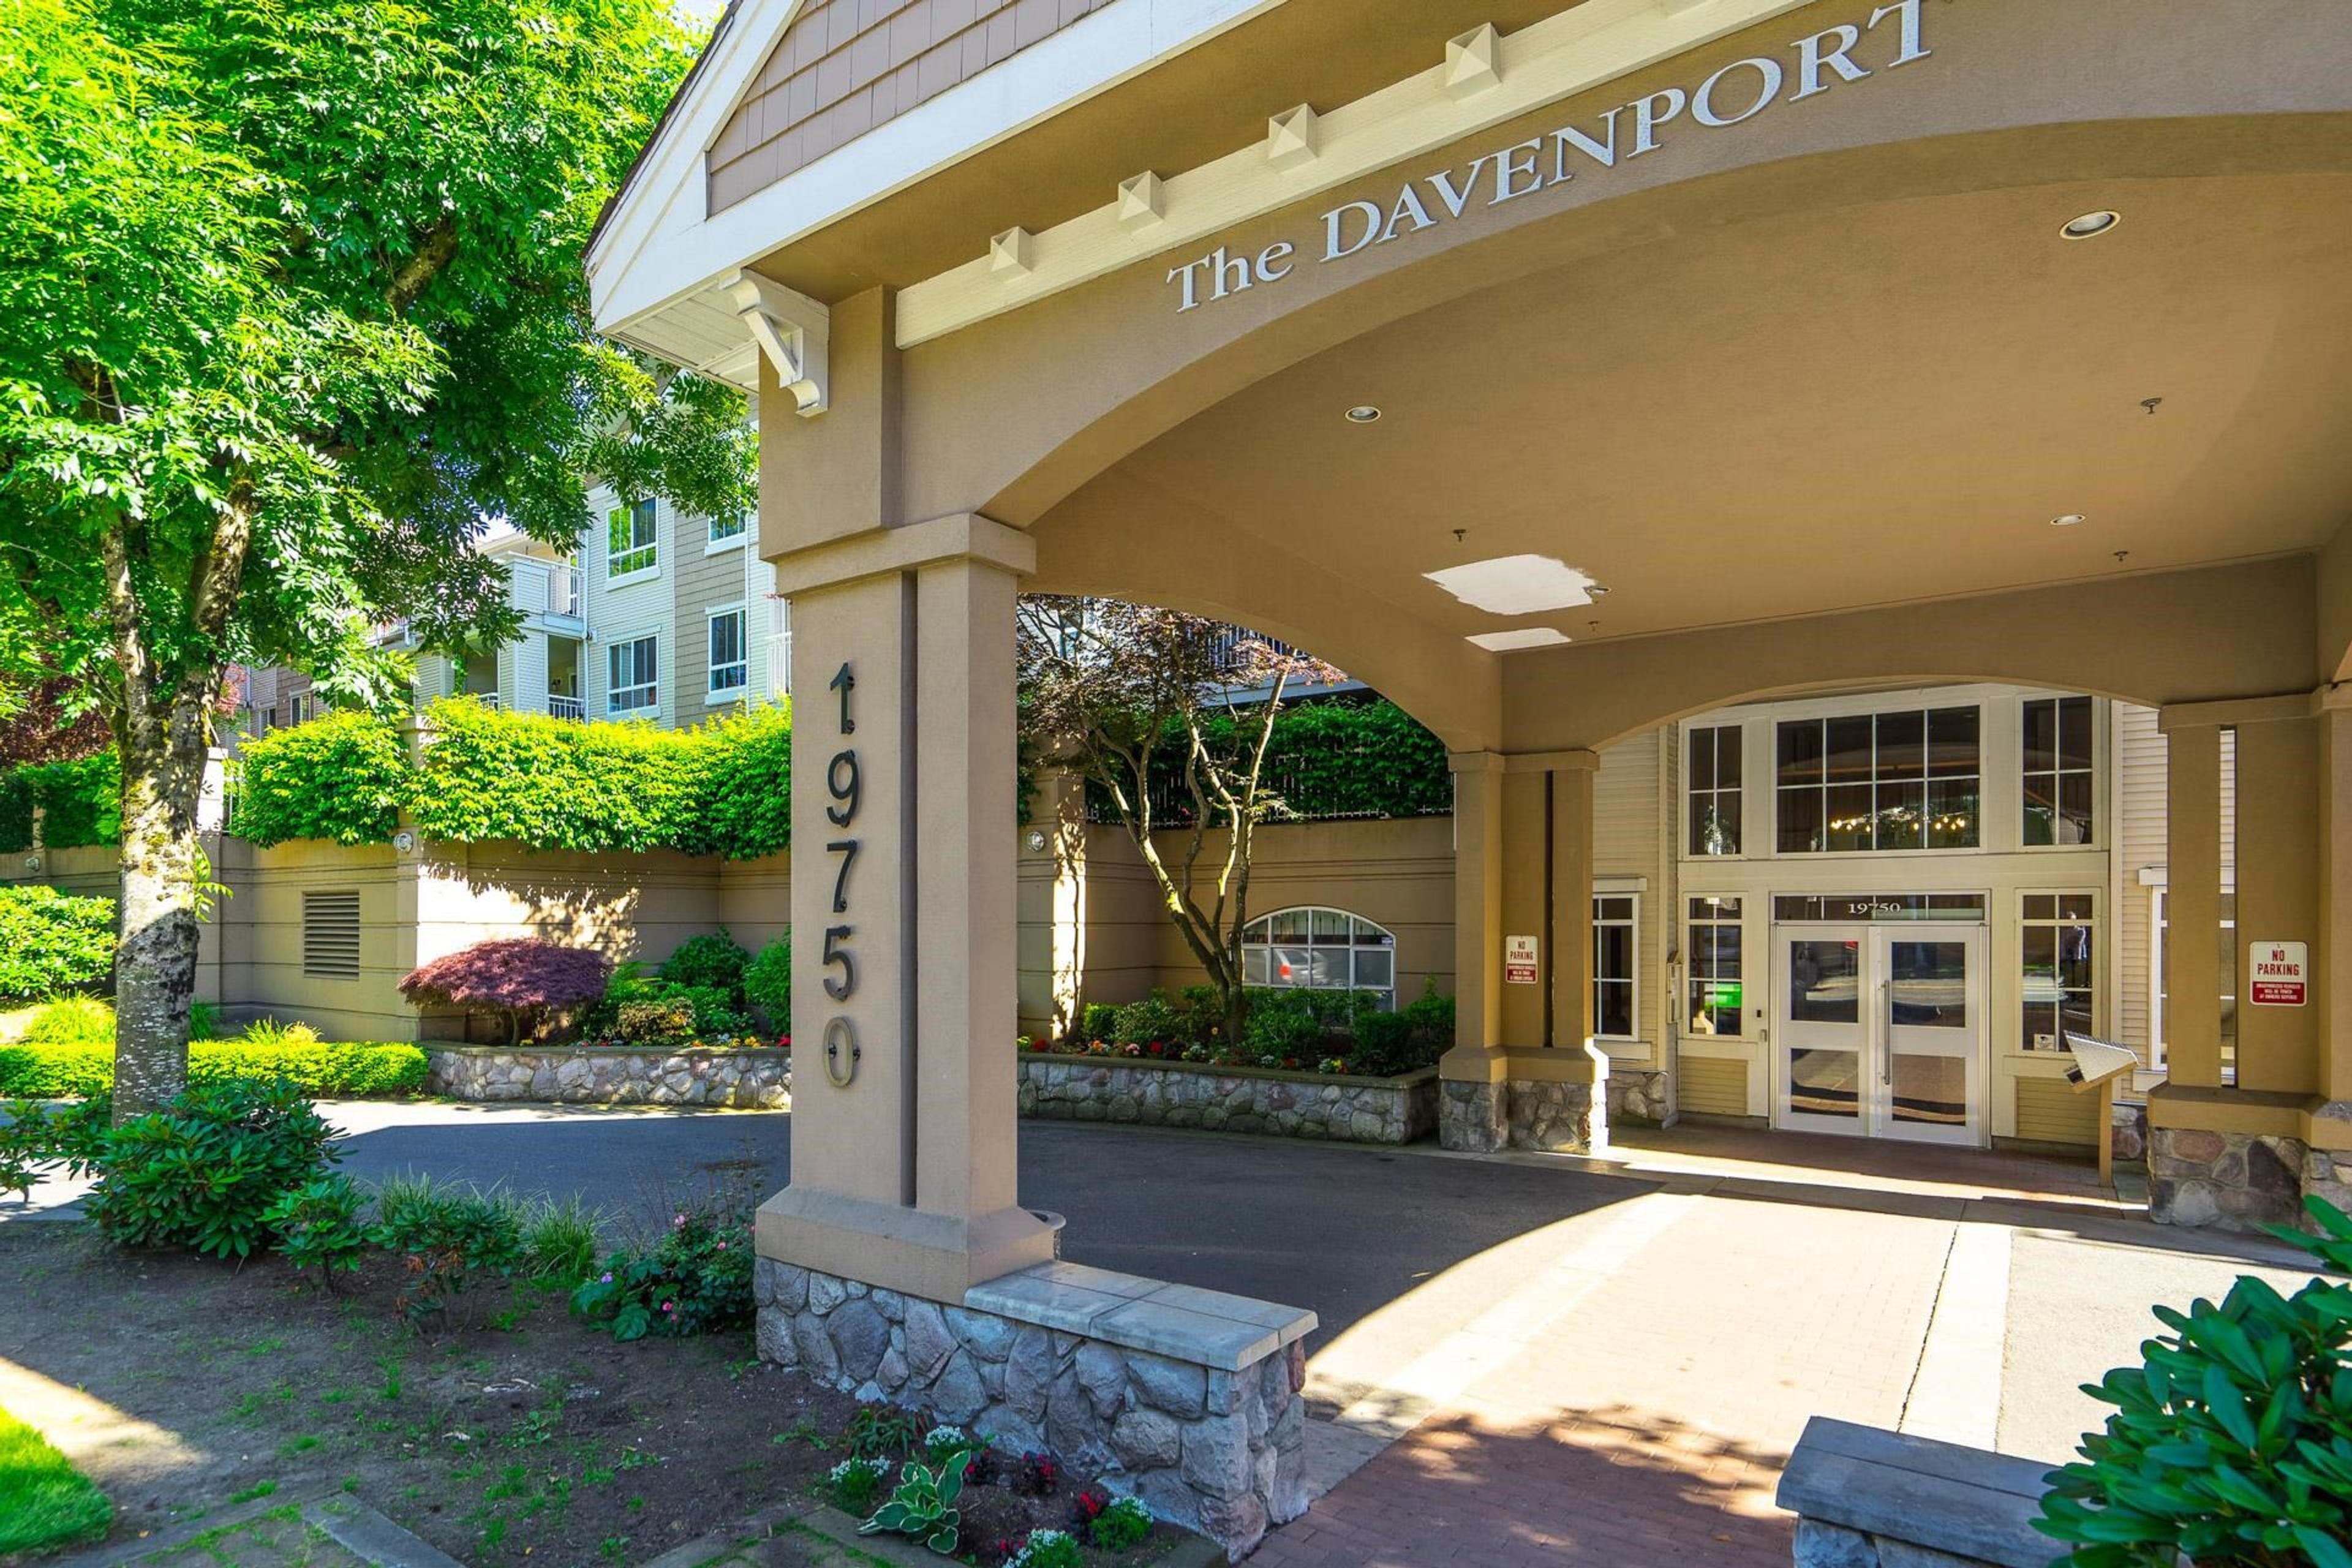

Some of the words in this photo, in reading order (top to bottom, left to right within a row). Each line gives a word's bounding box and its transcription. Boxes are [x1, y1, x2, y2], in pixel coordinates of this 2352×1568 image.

[1166, 241, 1295, 314] The
[1320, 0, 1933, 263] DAVENPORT
[823, 662, 859, 1087] 19750
[1847, 902, 1901, 914] 19750
[1510, 951, 1533, 960] PARKING
[2272, 950, 2285, 961] NO
[2258, 963, 2299, 976] PARKING
